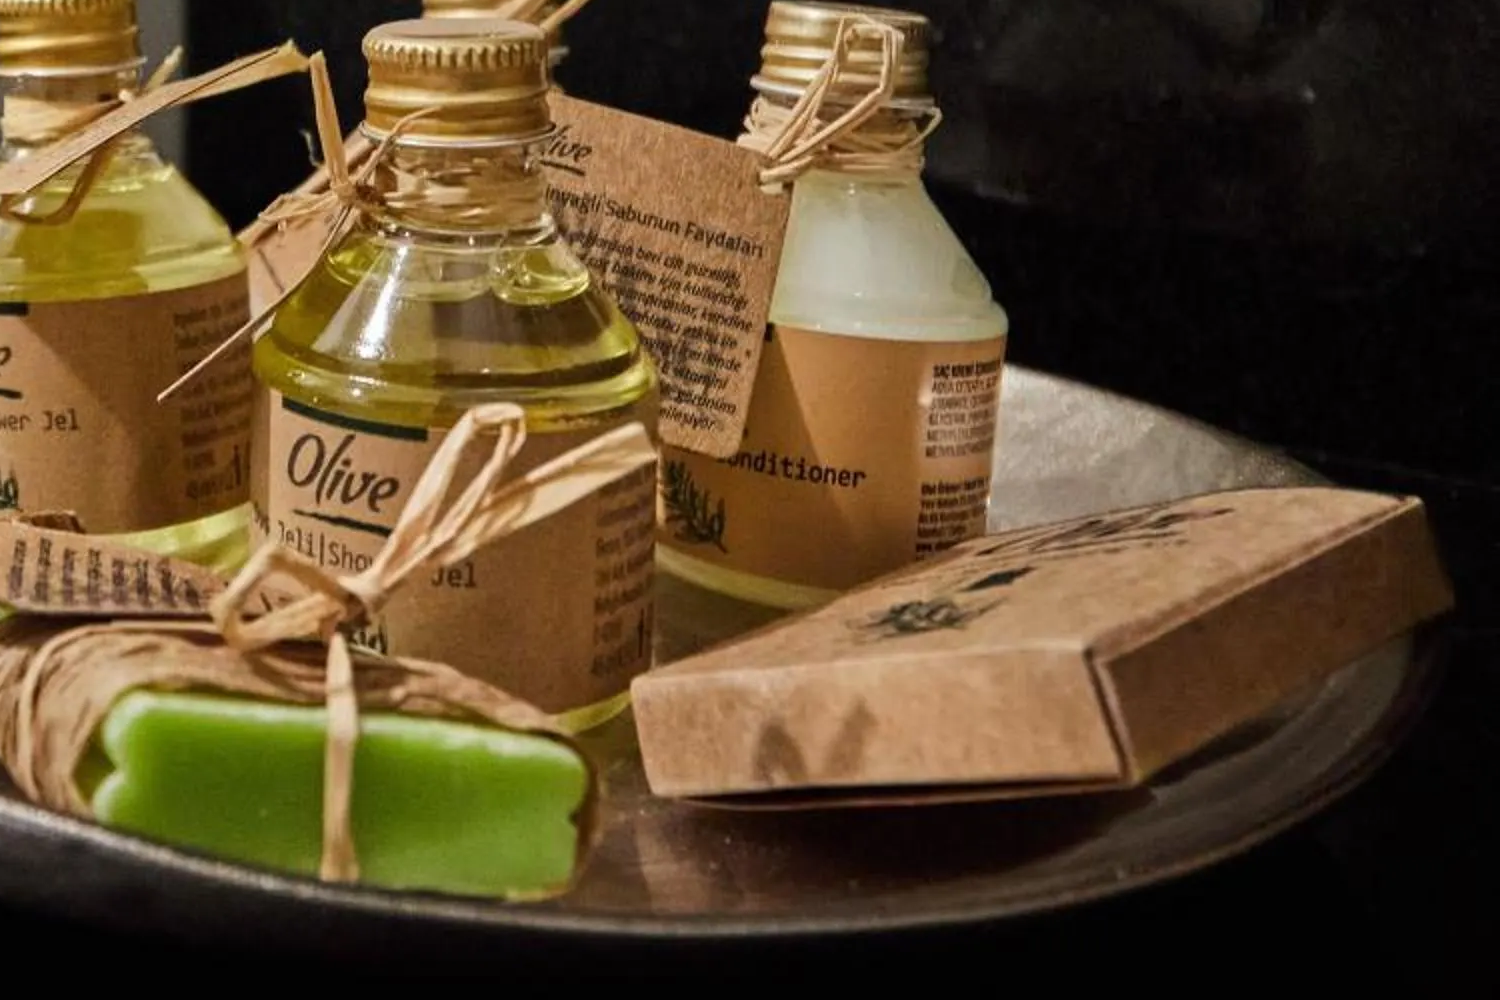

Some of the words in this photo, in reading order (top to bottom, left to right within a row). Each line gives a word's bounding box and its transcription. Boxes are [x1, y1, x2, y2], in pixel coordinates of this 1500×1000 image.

[542, 123, 593, 163] live
[604, 199, 681, 236] Sabunun
[42, 408, 80, 432] Jel
[286, 431, 400, 512] Olive
[716, 449, 868, 489] onditioner
